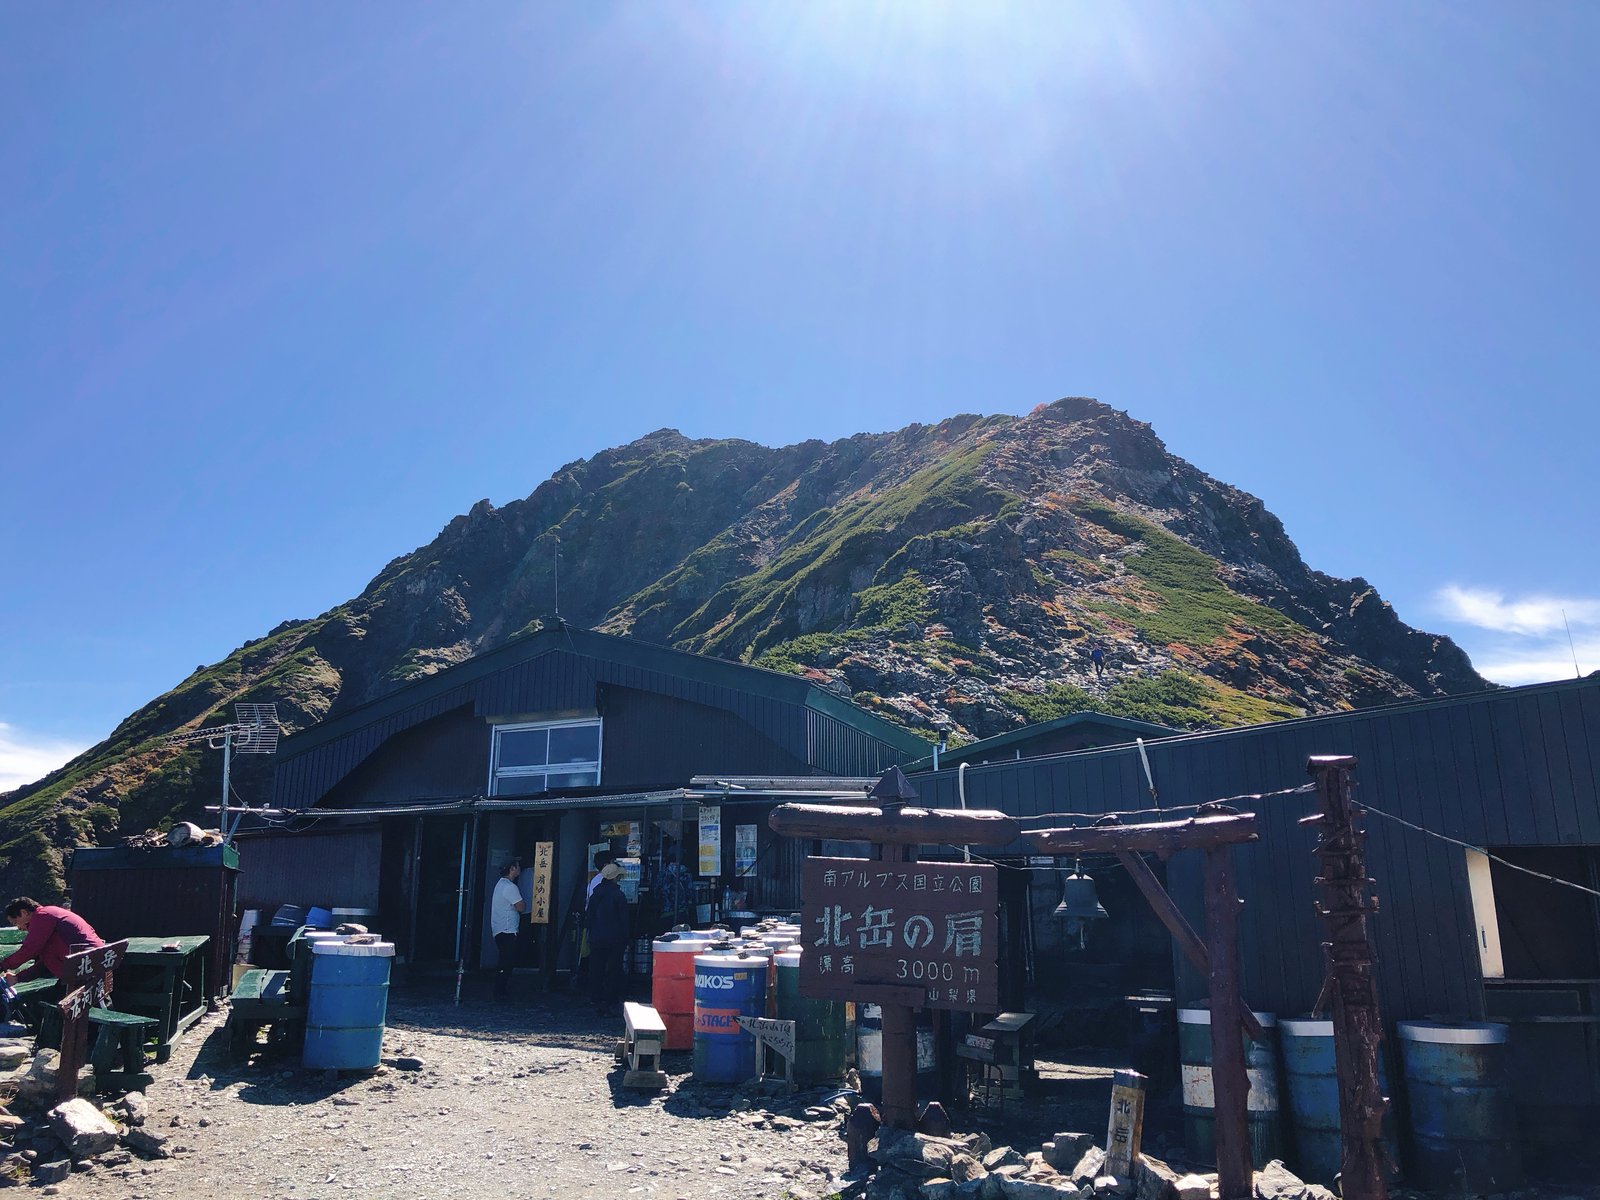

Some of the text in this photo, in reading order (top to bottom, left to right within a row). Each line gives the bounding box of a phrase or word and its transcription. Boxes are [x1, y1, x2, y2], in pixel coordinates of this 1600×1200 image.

[823, 869, 982, 894] 南アルプス国立公園
[814, 904, 984, 957] 北岳の肩
[77, 949, 117, 976] 北岳
[896, 959, 953, 981] 3000
[928, 988, 976, 1004] 山梨県
